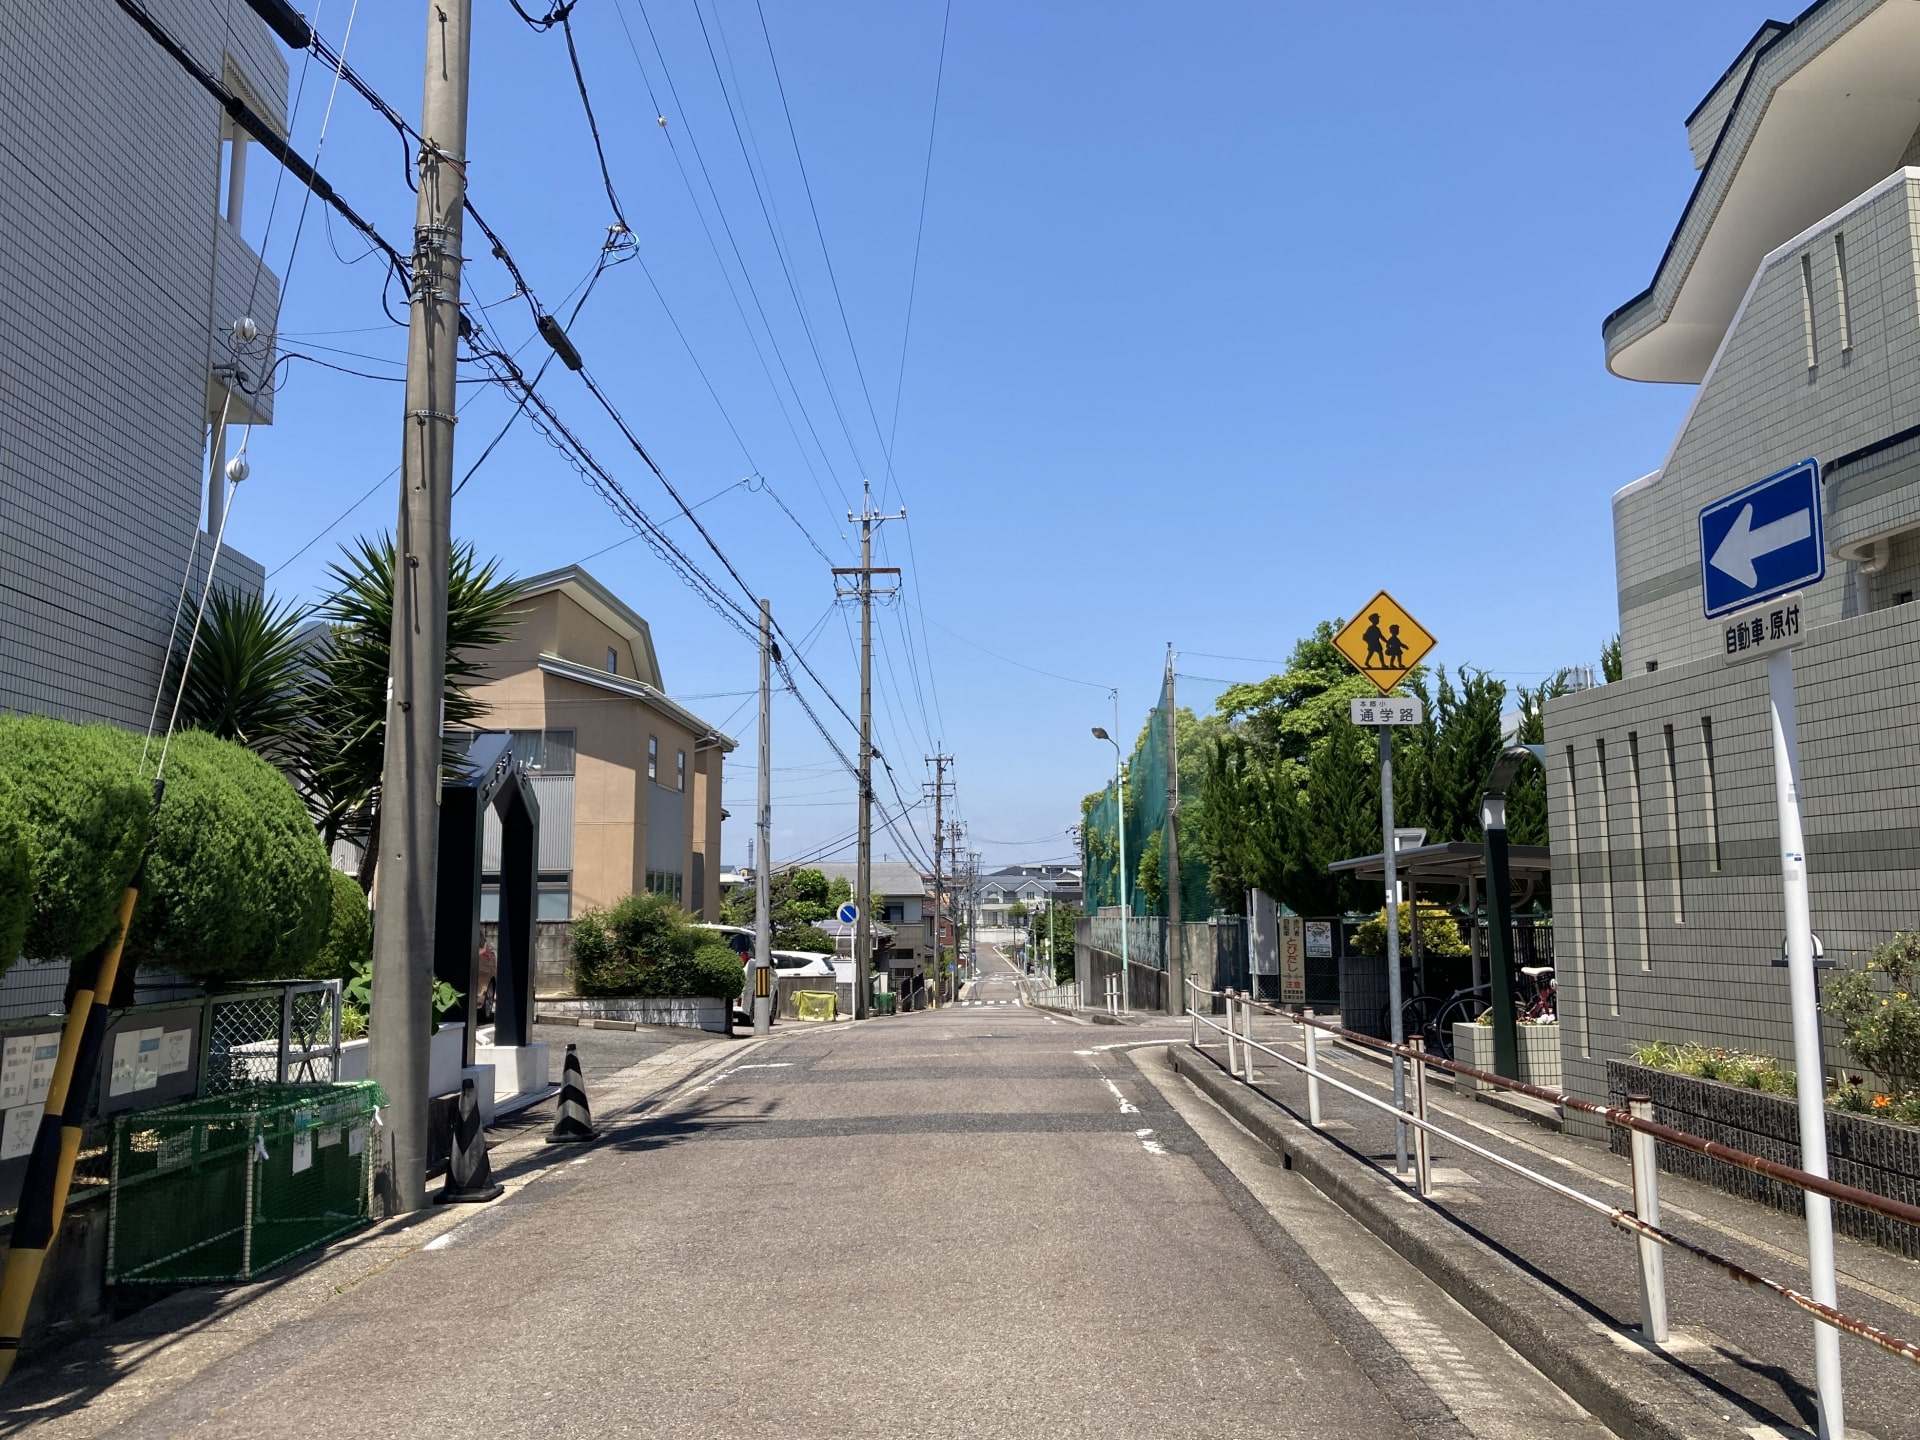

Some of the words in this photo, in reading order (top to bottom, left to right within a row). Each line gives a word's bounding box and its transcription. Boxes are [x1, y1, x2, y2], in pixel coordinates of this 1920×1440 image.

[1726, 604, 1800, 654] 自動車・原付
[1360, 708, 1414, 722] 通学路
[1286, 937, 1298, 972] とびだし
[1285, 980, 1301, 989] 注意
